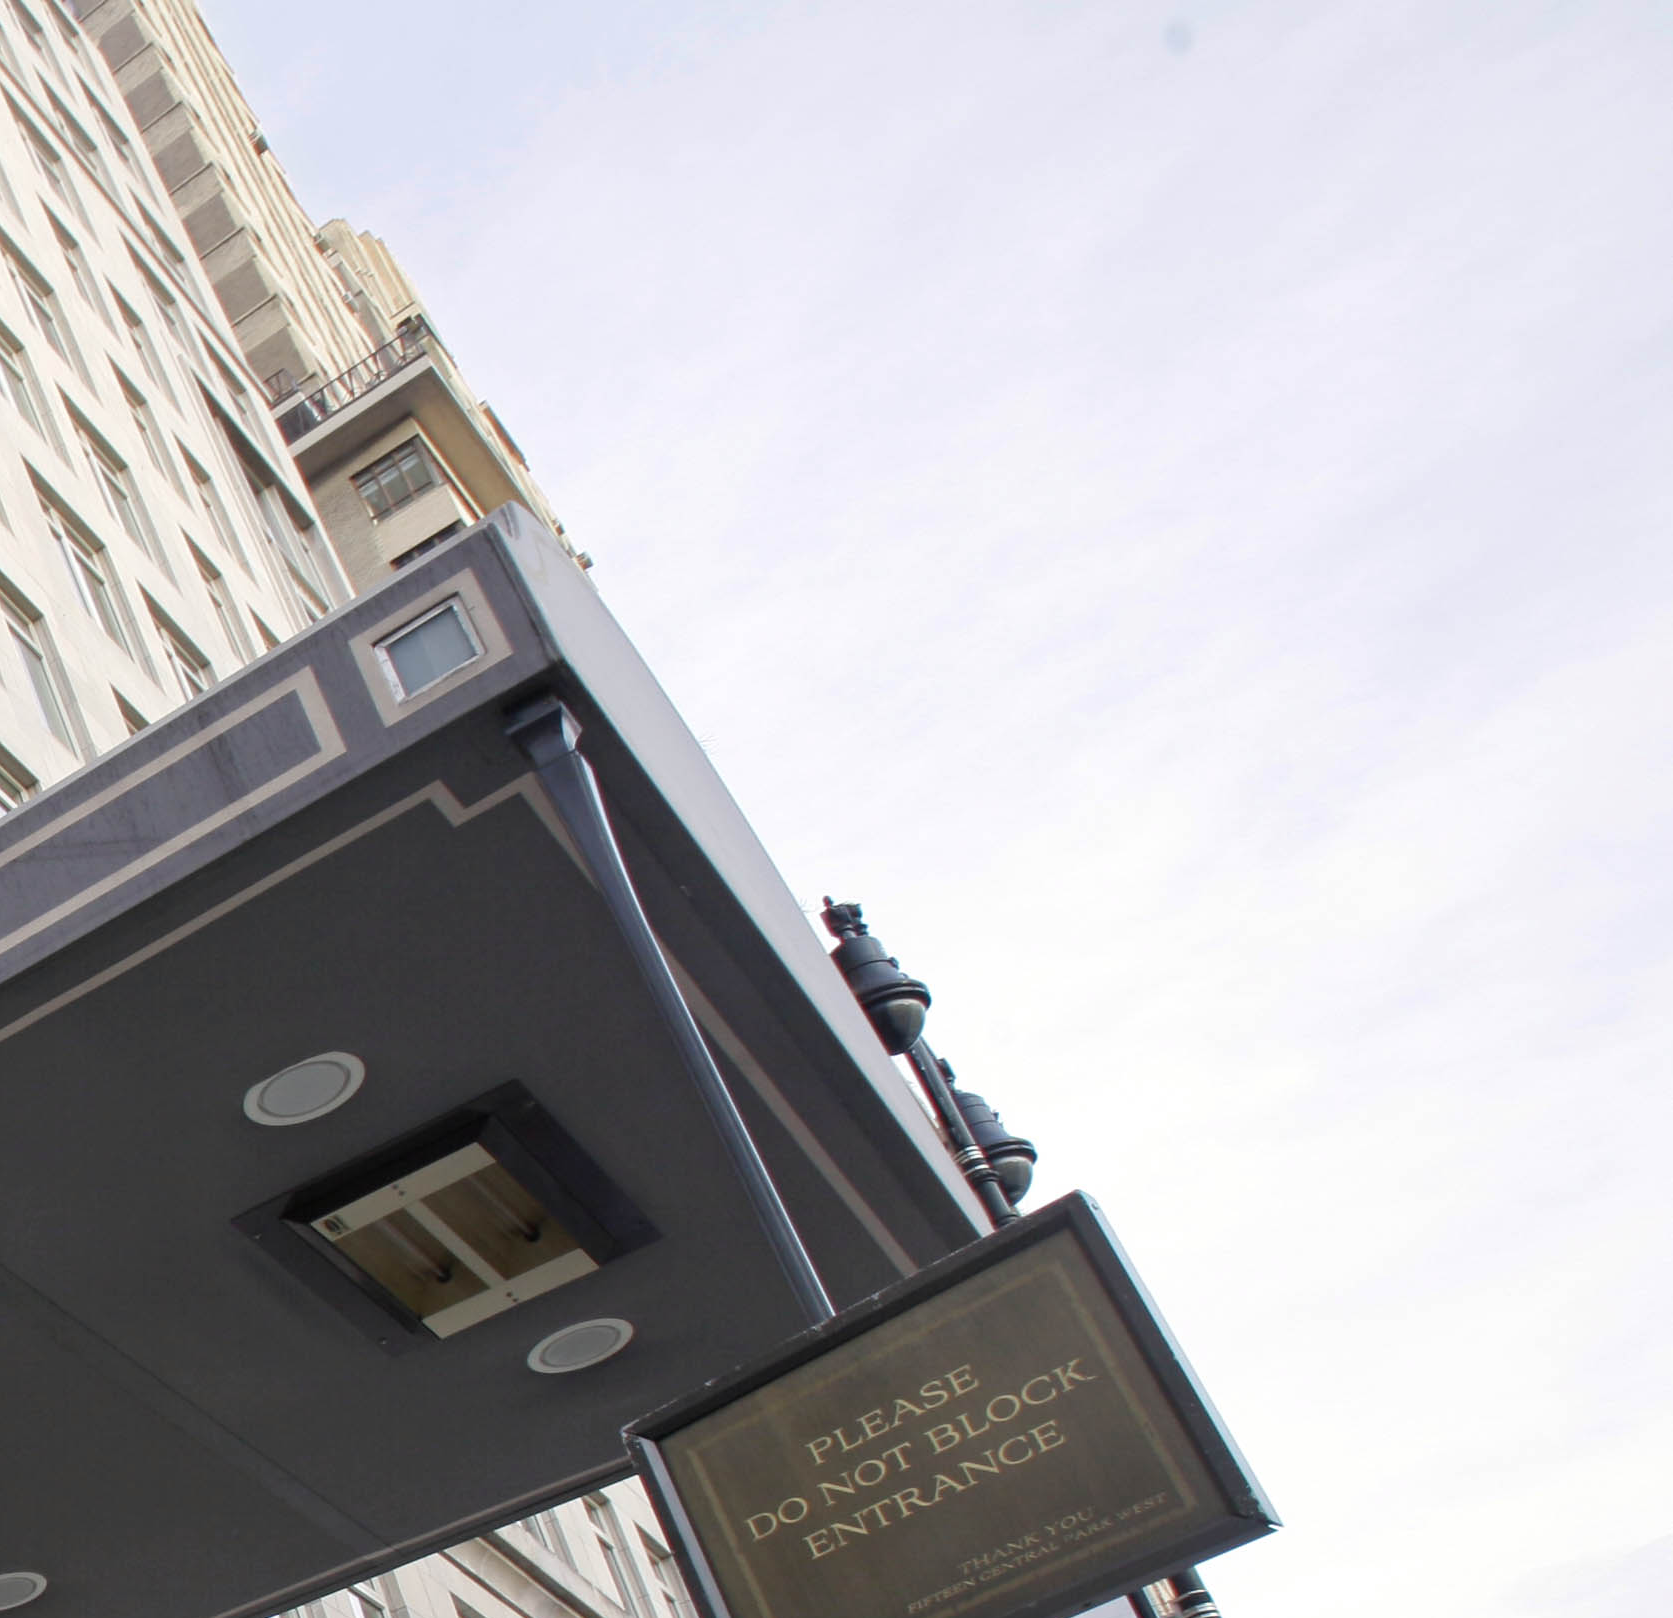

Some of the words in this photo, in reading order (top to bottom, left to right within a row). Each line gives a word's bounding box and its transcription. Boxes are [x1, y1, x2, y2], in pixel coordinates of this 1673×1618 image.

[744, 1496, 808, 1543] DO
[816, 1441, 912, 1507] NOT
[923, 1357, 1097, 1455] BLOCK
[805, 1363, 980, 1466] PLEASE
[802, 1418, 1066, 1560] ENTRANCE
[957, 1531, 1040, 1576] THANK
[1043, 1505, 1096, 1537] YOU
[907, 1579, 977, 1615] FIFTEEN
[978, 1542, 1059, 1582] CENTRAL
[1063, 1517, 1112, 1543] PARK
[1116, 1491, 1168, 1520] WEST
